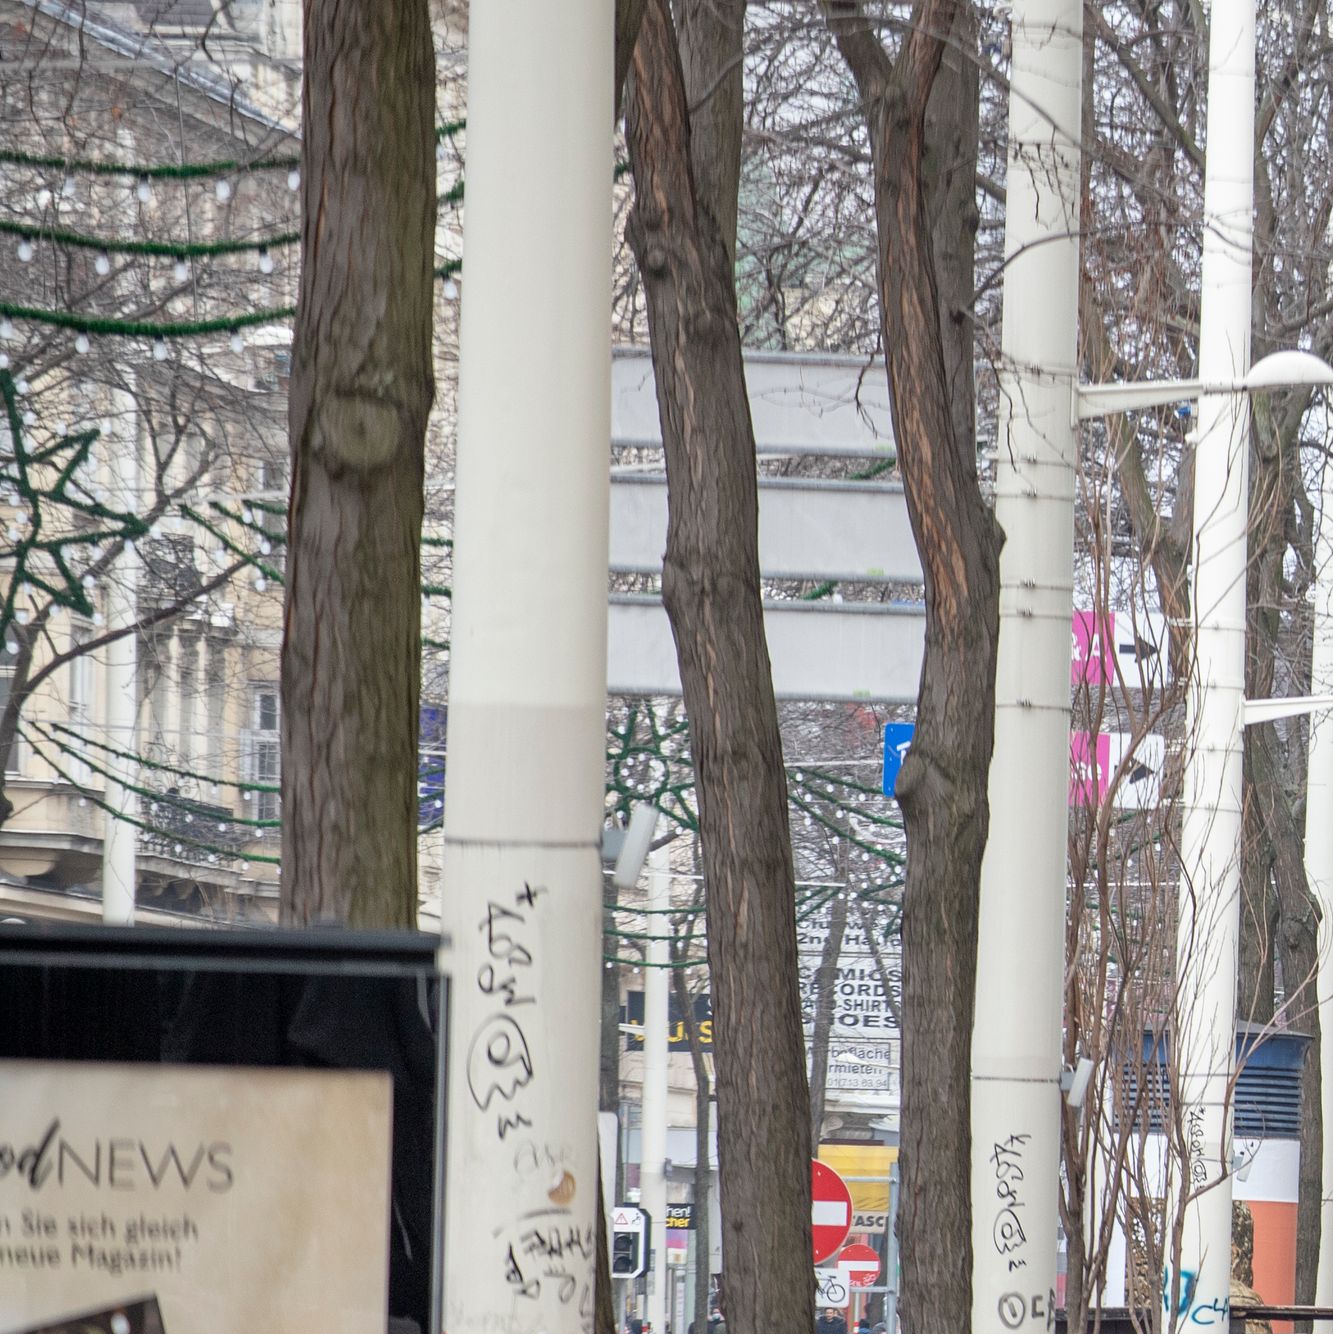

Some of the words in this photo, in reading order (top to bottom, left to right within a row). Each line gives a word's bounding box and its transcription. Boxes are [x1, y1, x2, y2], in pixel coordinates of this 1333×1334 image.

[58, 1138, 235, 1195] NEWS
[125, 1210, 200, 1246] gleich
[71, 1241, 183, 1277] Magazin!
